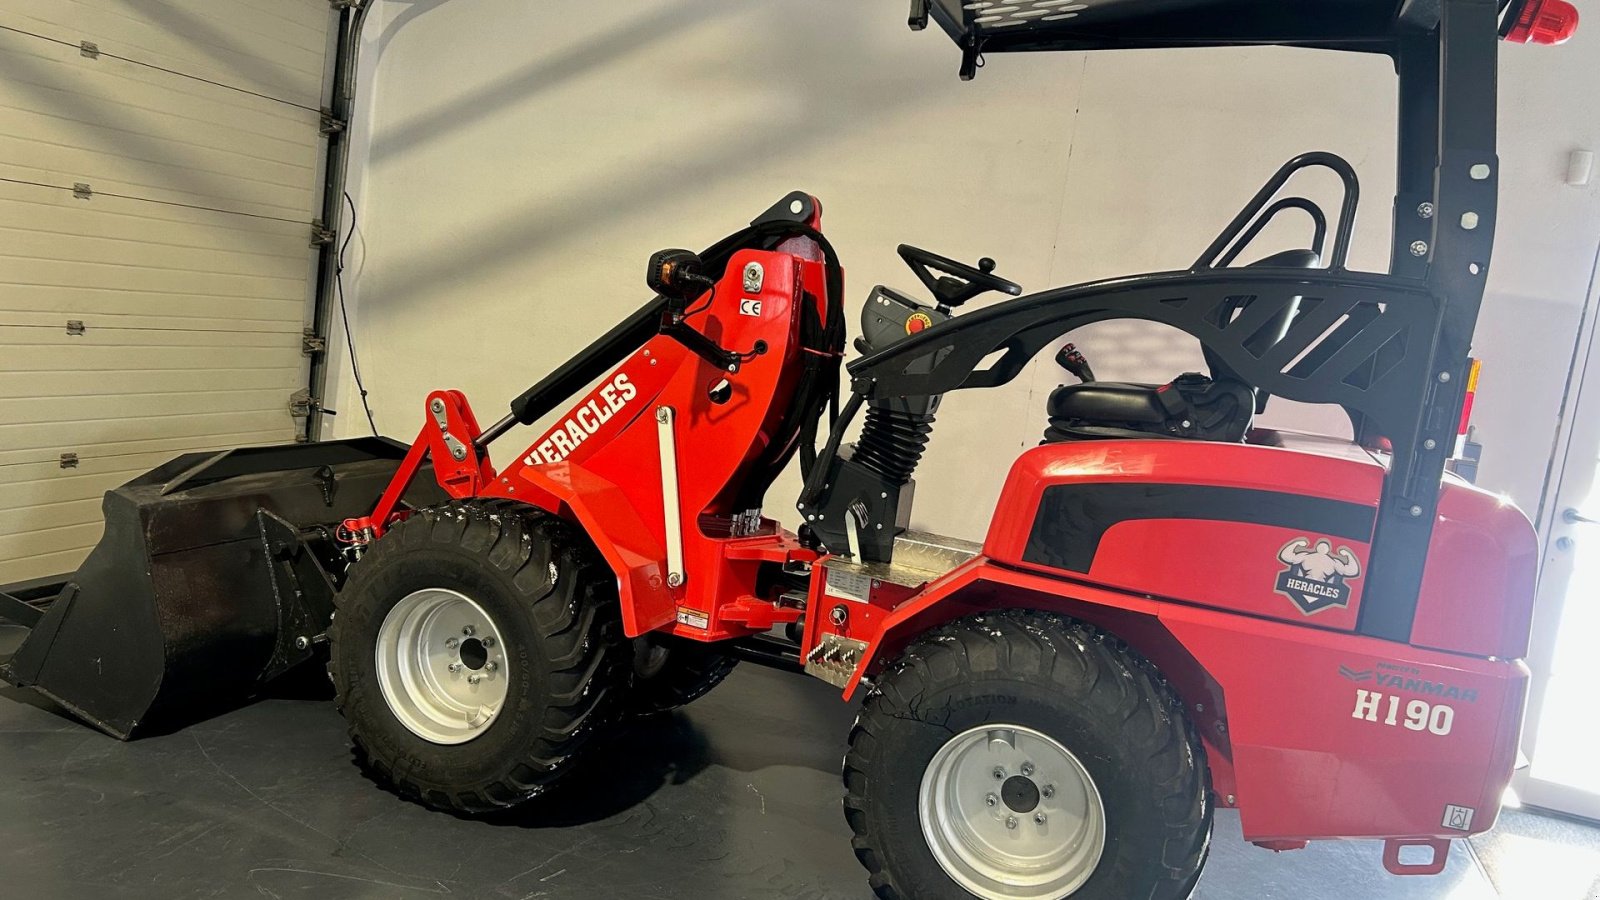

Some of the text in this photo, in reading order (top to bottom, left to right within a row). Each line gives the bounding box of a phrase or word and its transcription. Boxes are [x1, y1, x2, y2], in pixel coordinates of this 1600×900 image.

[741, 300, 760, 315] CE
[1286, 578, 1340, 599] HERACLES
[1376, 672, 1479, 702] YANMAR
[1352, 689, 1455, 736] H190
